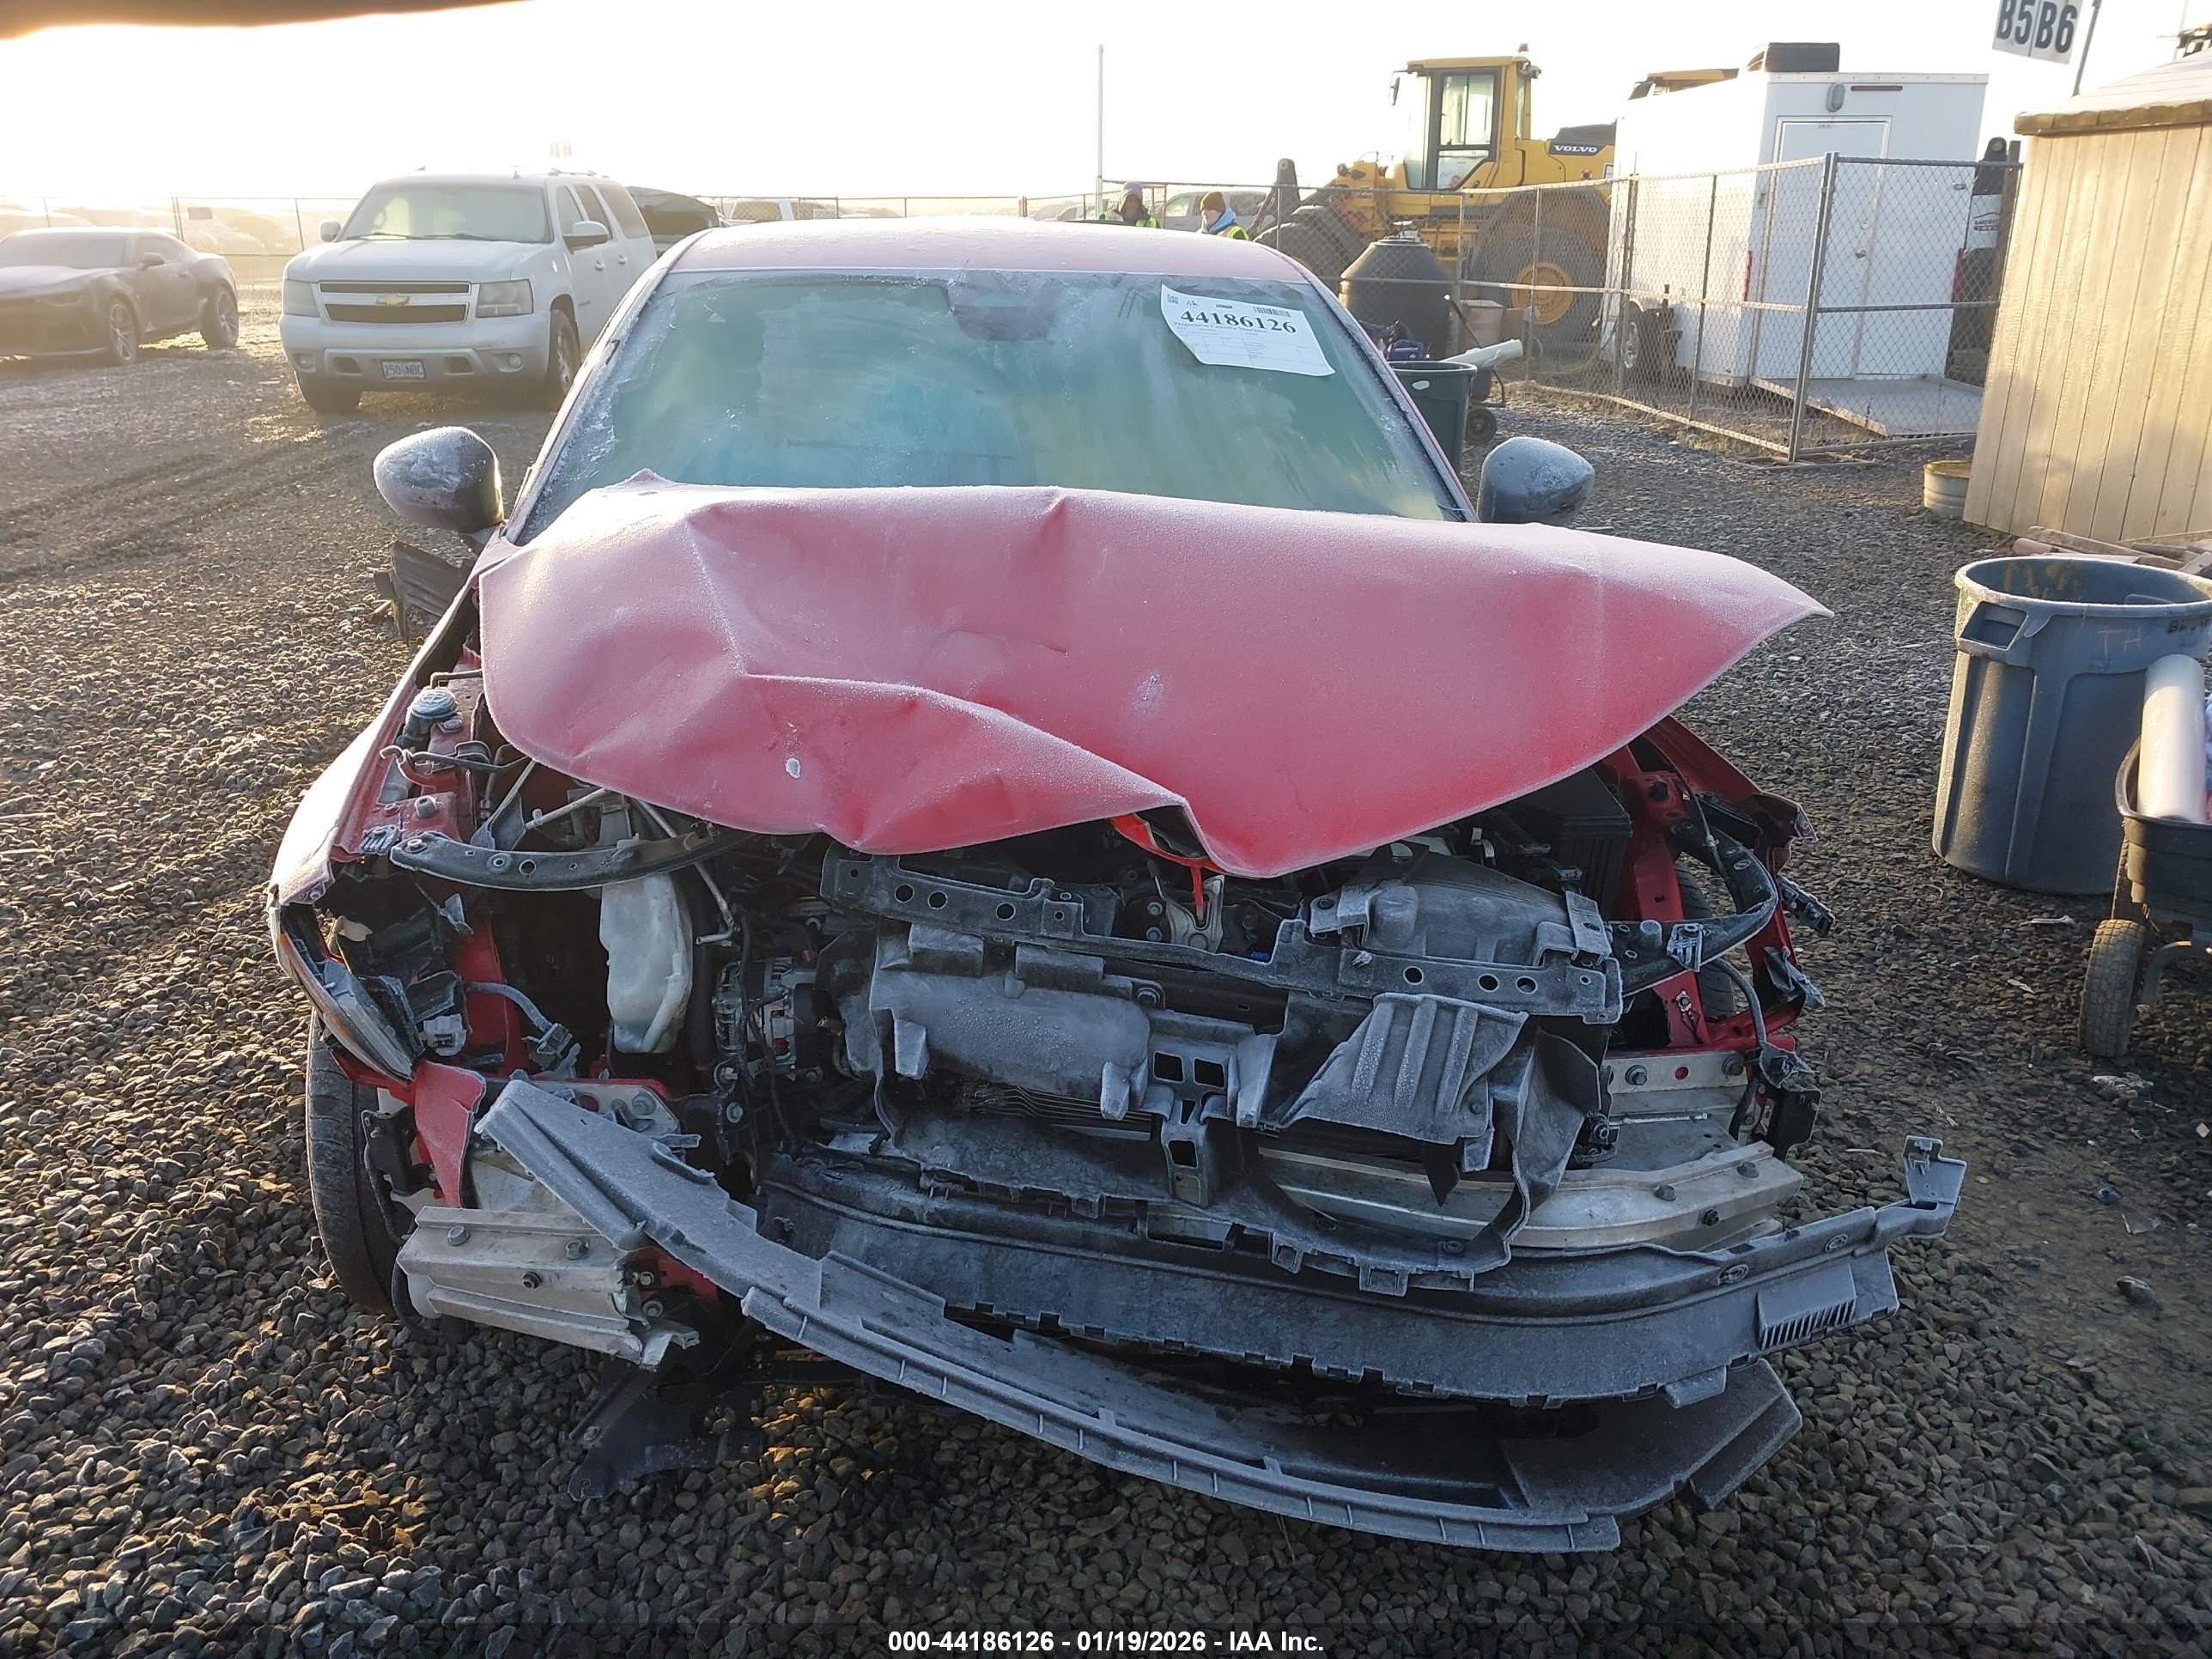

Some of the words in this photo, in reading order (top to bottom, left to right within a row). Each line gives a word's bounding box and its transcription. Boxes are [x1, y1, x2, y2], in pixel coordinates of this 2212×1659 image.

[1996, 0, 2035, 45] B5
[2034, 1, 2077, 53] B6
[1553, 144, 1598, 153] VOLVO
[1181, 310, 1297, 334] 44186126
